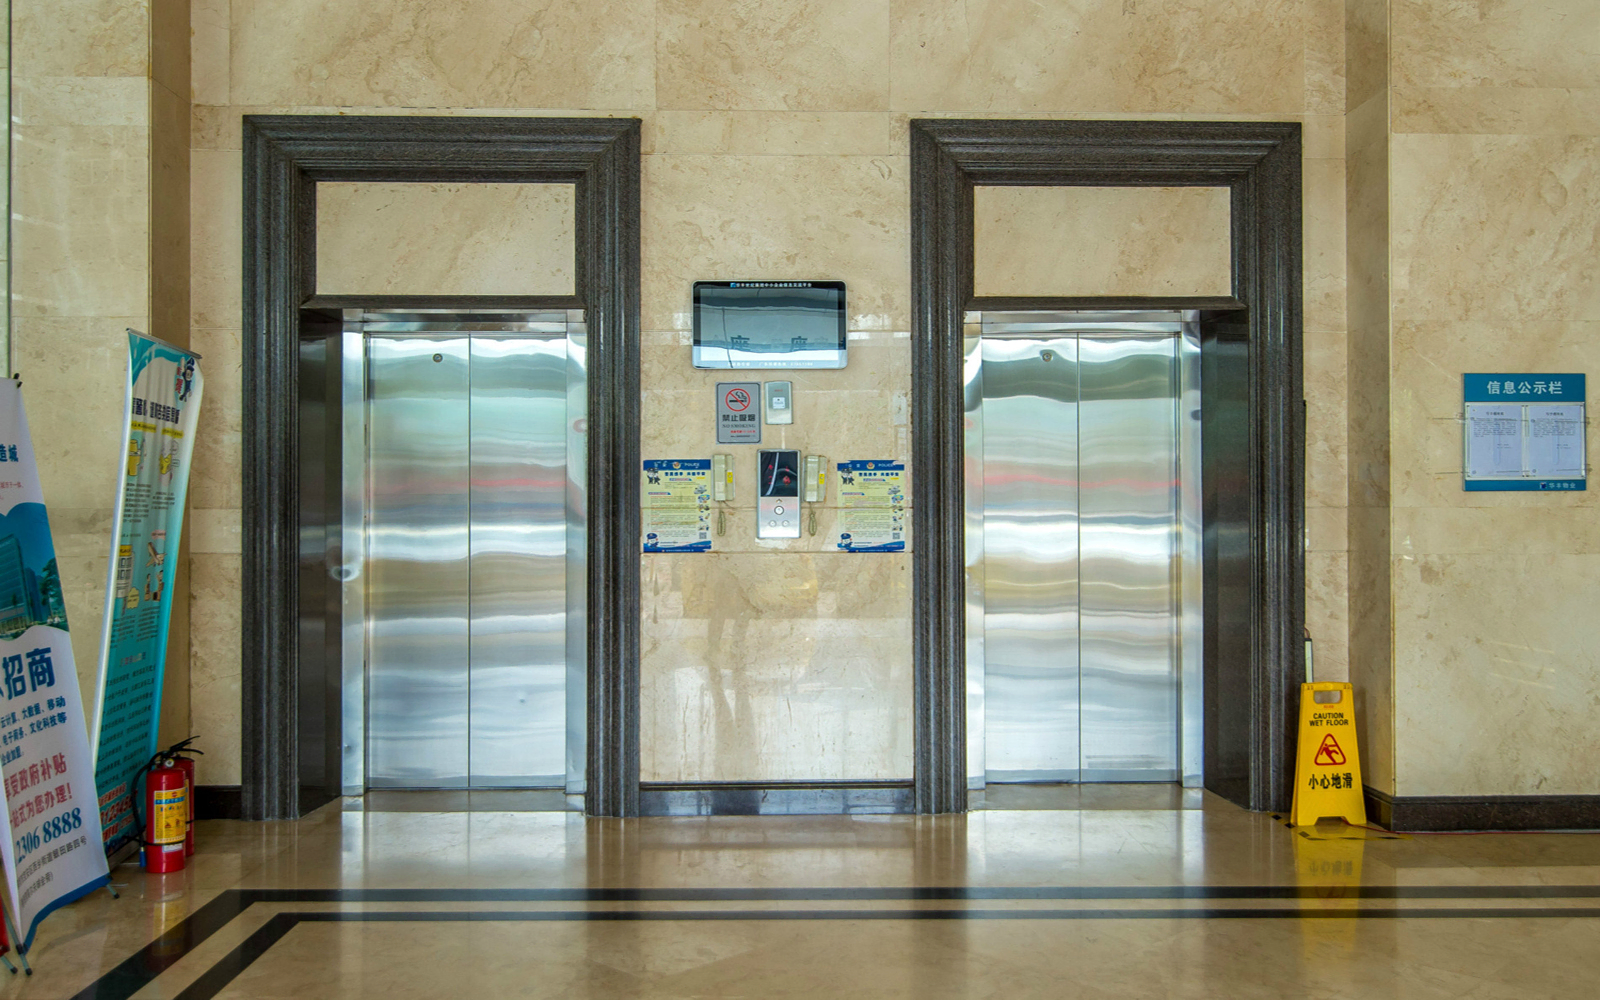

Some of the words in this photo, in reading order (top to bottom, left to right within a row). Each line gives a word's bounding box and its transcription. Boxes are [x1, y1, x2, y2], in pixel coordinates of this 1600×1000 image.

[1486, 380, 1563, 395] 信息公示栏
[722, 413, 756, 422] 禁止吸烟
[0, 647, 55, 701] 招商
[1309, 719, 1323, 727] WET
[1325, 718, 1349, 726] FLOOR
[1313, 712, 1344, 720] CAUTION
[1308, 772, 1353, 790] 小心地滑
[42, 807, 82, 844] 8888
